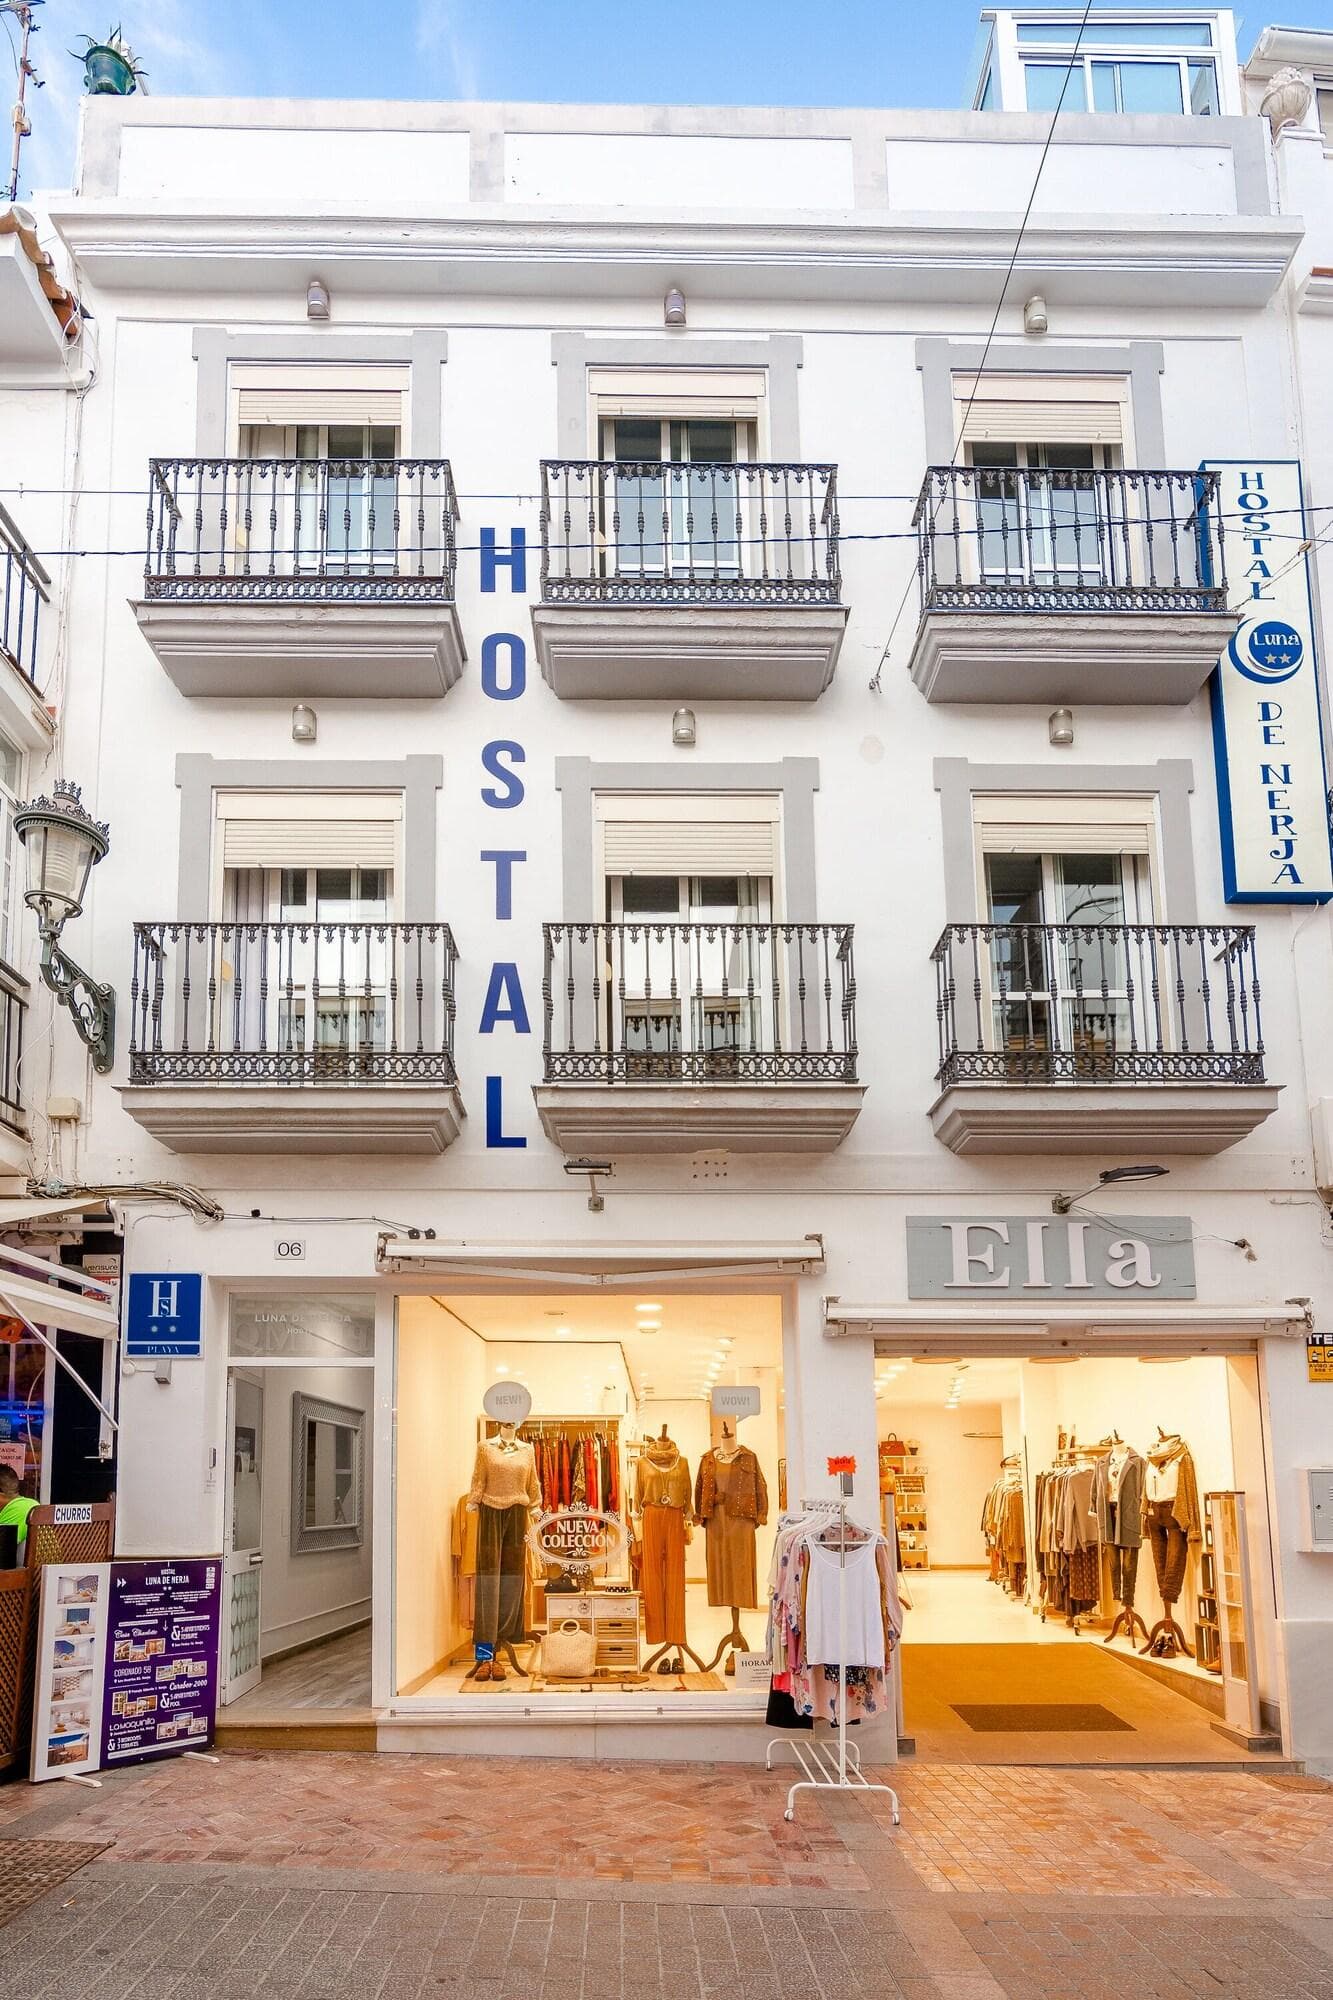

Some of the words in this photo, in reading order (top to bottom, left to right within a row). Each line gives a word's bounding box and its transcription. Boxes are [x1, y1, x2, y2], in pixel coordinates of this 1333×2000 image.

[1238, 472, 1275, 600] HOSTAL
[1253, 631, 1300, 646] Luna
[1257, 701, 1285, 745] DE
[1260, 763, 1304, 885] NERJA
[478, 527, 531, 1148] HOSTAL
[277, 1242, 302, 1257] 06
[941, 1222, 1162, 1289] Ella
[254, 1313, 287, 1323] LUNA
[147, 1345, 180, 1353] PLAYA
[495, 1395, 522, 1405] NEW!
[721, 1395, 750, 1406] WOW!
[55, 1508, 91, 1521] CHURROS
[557, 1520, 599, 1534] NUEVA
[542, 1532, 616, 1548] COLECCIÓN
[162, 1576, 171, 1584] DE
[171, 1575, 190, 1584] NERJA
